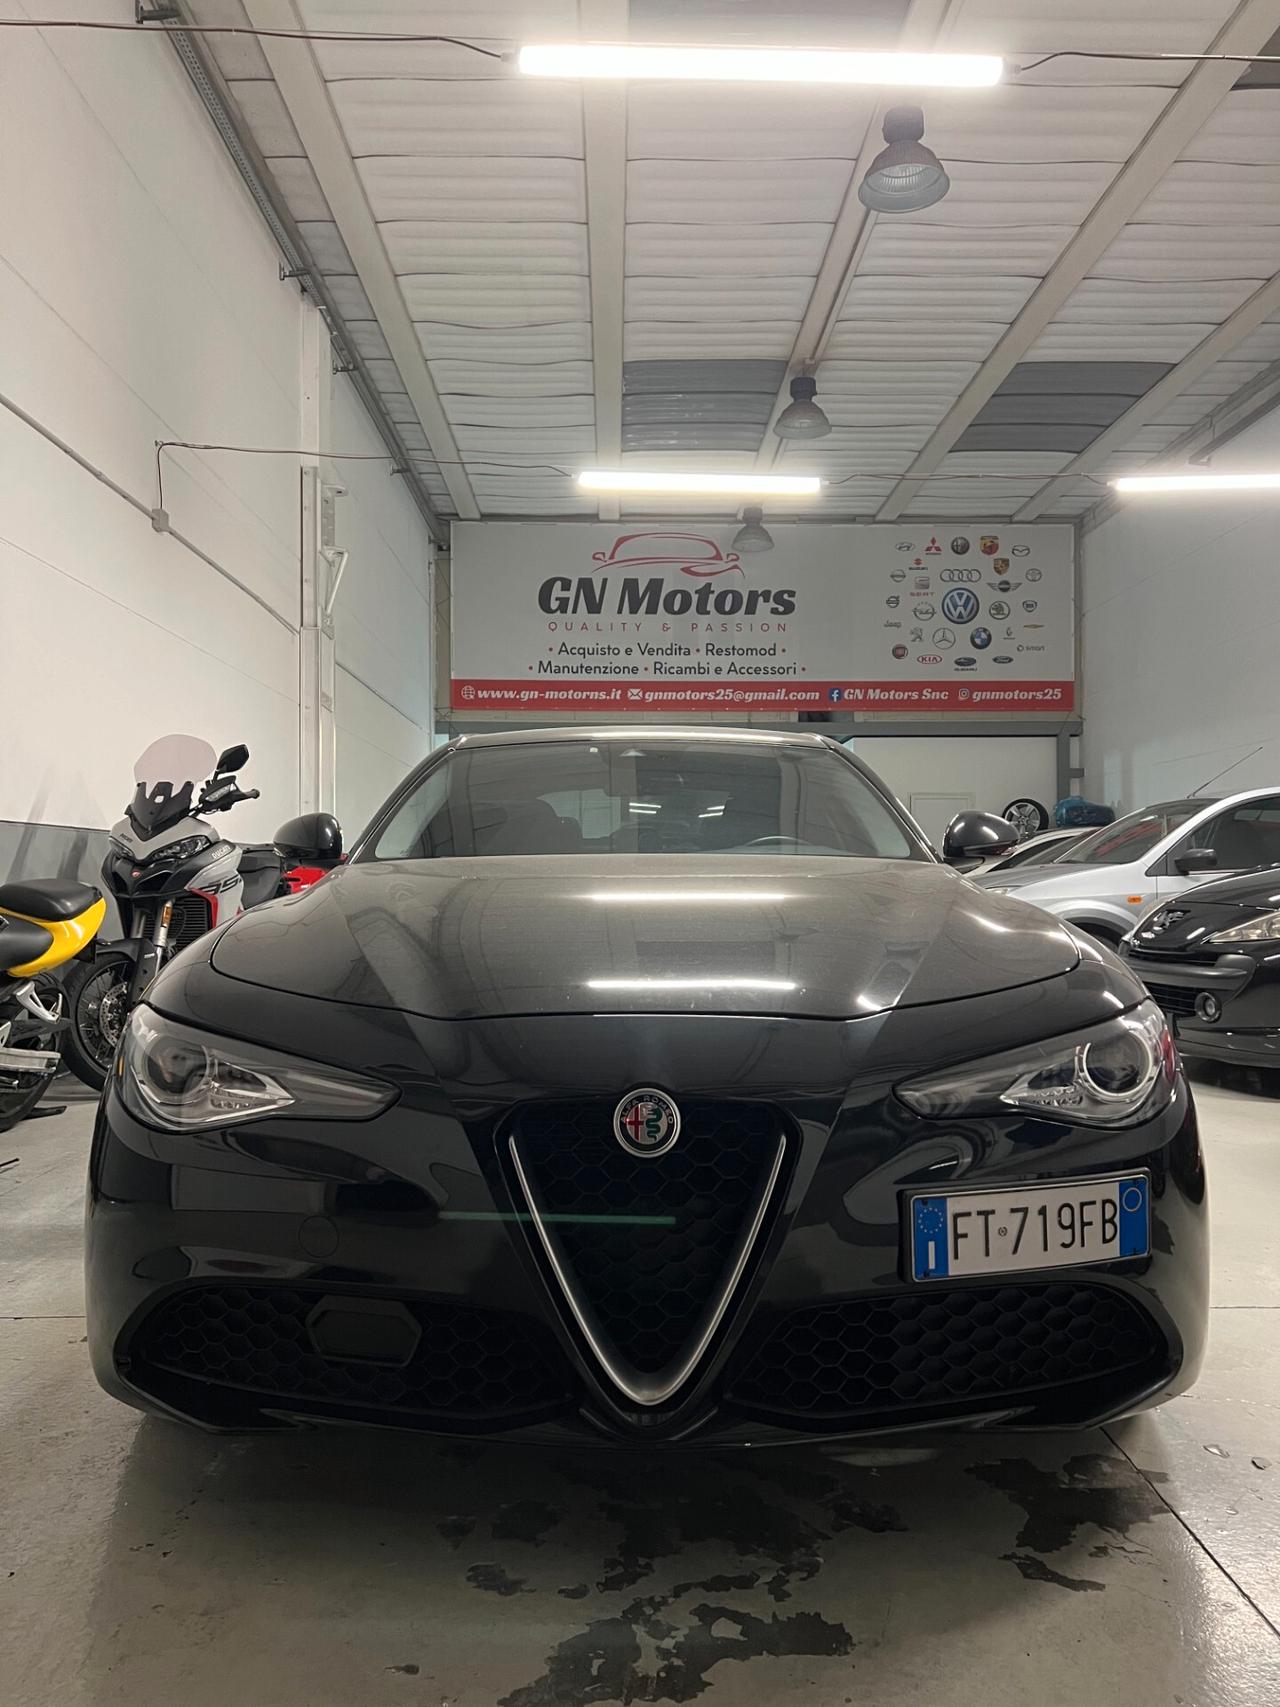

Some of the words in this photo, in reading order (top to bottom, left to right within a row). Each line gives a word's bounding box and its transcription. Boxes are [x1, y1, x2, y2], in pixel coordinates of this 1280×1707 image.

[537, 576, 609, 615] GN
[616, 577, 797, 616] Motors
[548, 621, 642, 632] QUALITY
[661, 622, 671, 632] &
[691, 622, 786, 633] PASSION
[557, 641, 621, 659] Acquisto
[624, 647, 633, 656] e
[636, 642, 691, 656] Vendita
[705, 642, 777, 657] Restomod
[921, 655, 938, 663] KIA
[537, 660, 639, 675] Manutenzione
[653, 660, 710, 675] Ricambi
[714, 666, 723, 675] e
[726, 661, 797, 675] Accessori
[644, 688, 820, 702] gnmotors25@gmail.com
[843, 688, 865, 700] GN
[866, 688, 919, 701] Motors
[922, 688, 949, 701] Snc
[972, 688, 1062, 701] gnmotors25
